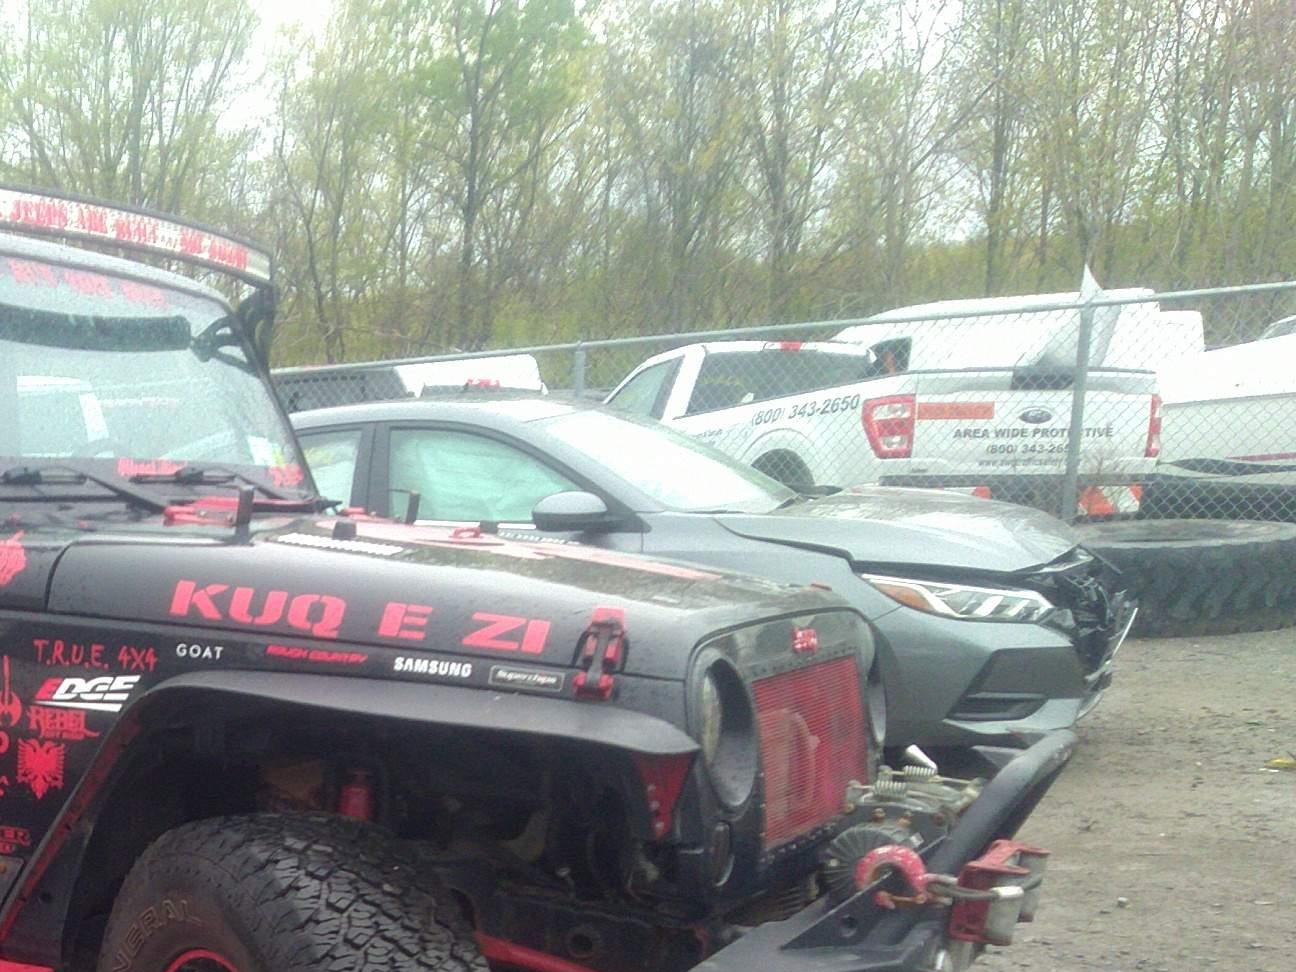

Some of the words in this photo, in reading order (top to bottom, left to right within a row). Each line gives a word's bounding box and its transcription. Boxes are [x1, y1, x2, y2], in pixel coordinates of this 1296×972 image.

[752, 407, 784, 426] (800)
[788, 394, 860, 419] 343-2650
[953, 428, 990, 438] AREA
[994, 427, 1028, 437] WIDE
[170, 580, 346, 638] KUQ
[378, 602, 433, 640] E
[462, 612, 551, 654] ZI
[176, 643, 224, 660] GOAT
[394, 657, 472, 677] SAMSUNG
[35, 675, 141, 701] EDGE
